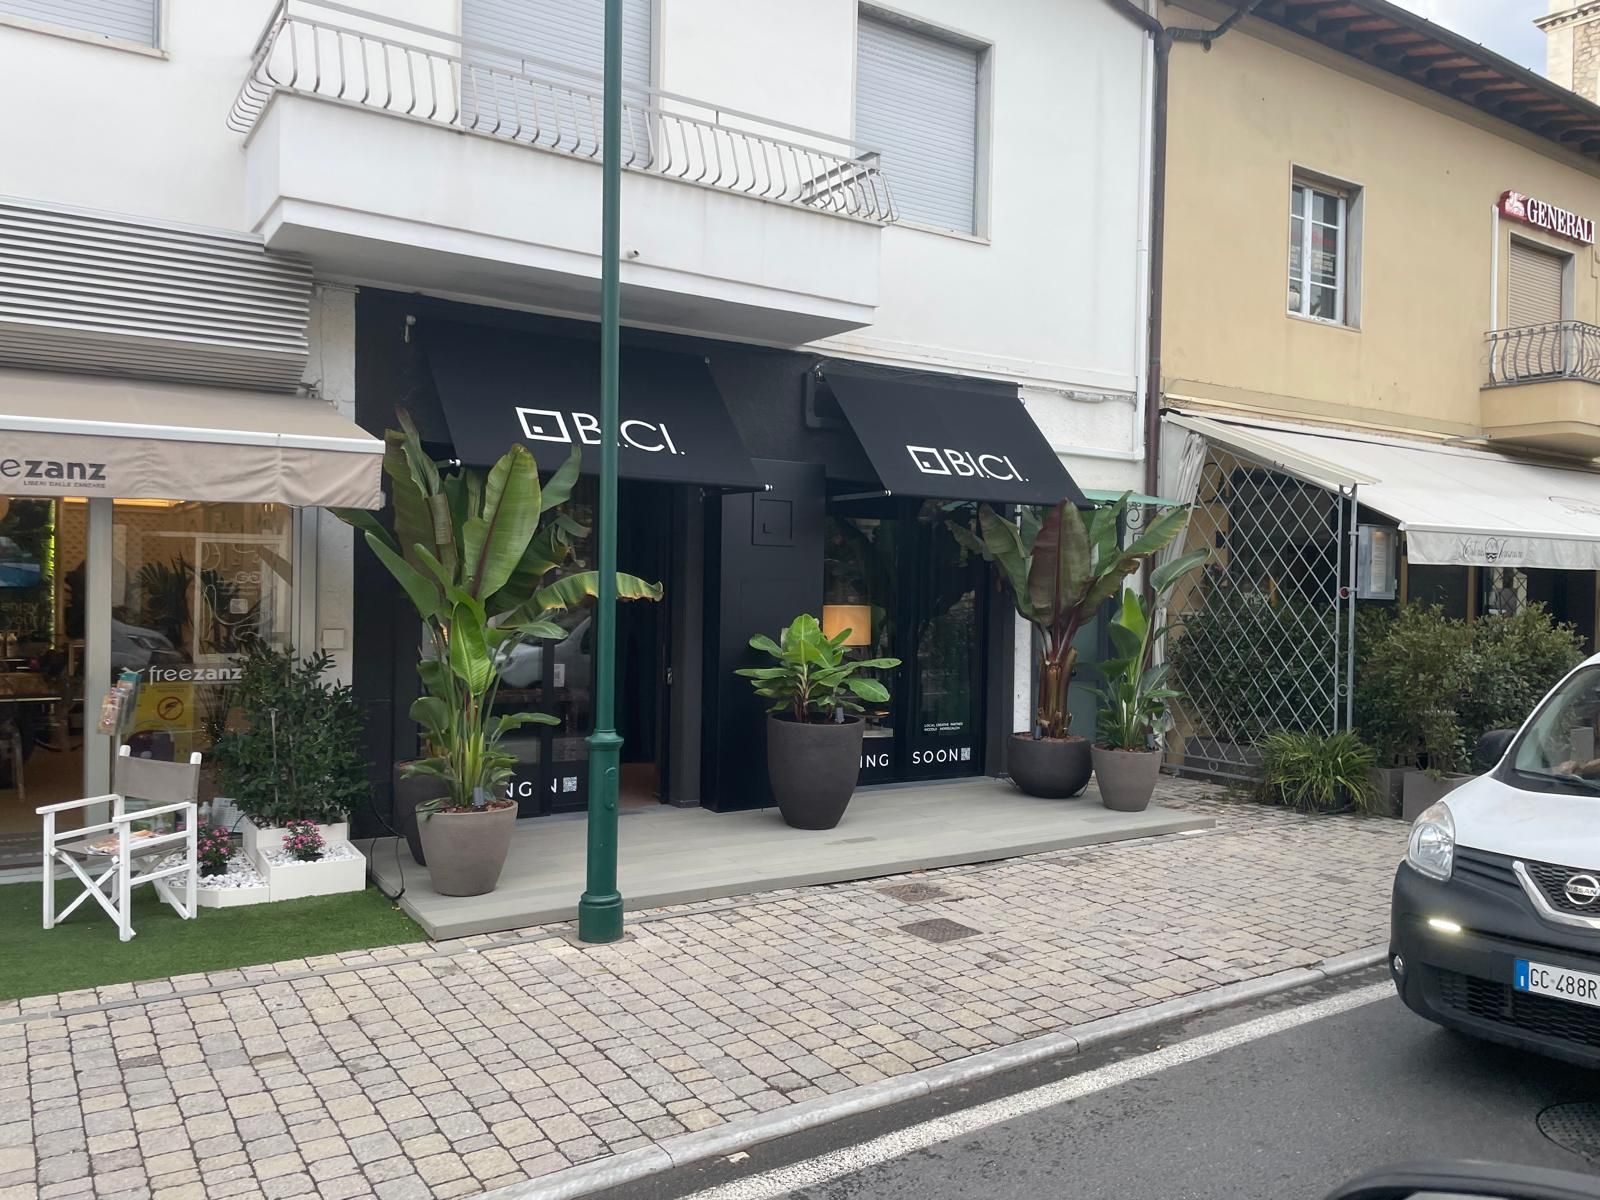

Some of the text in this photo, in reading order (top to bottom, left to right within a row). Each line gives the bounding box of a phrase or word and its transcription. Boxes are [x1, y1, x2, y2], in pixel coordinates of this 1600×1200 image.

[1527, 198, 1595, 244] GENERALI
[0, 458, 107, 481] ezanz
[148, 665, 243, 686] freezanz
[912, 748, 958, 765] SOON
[1566, 885, 1597, 896] NISSAN
[1530, 968, 1598, 1000] GC 488R
